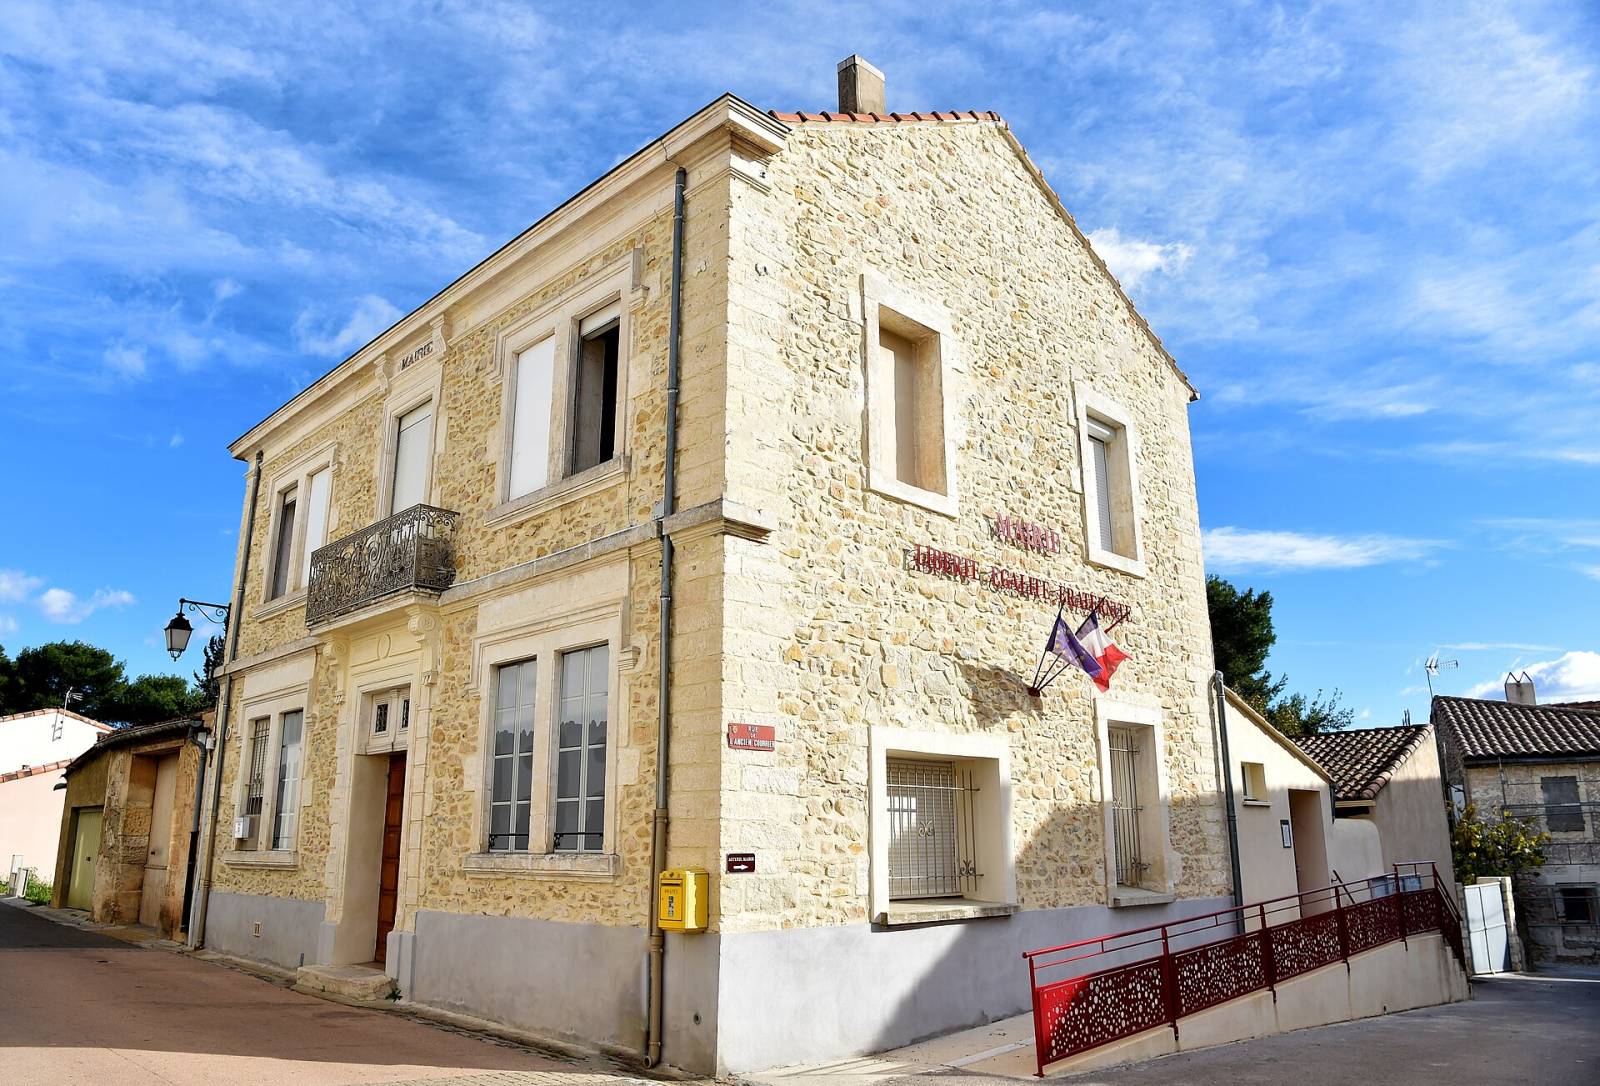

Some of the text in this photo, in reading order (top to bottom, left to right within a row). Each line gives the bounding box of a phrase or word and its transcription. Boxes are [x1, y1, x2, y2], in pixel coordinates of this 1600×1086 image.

[400, 340, 434, 371] MAIRIE
[995, 511, 1061, 555] MAIRIE
[747, 725, 758, 733] RUE
[729, 737, 752, 747] L'ANCIEN
